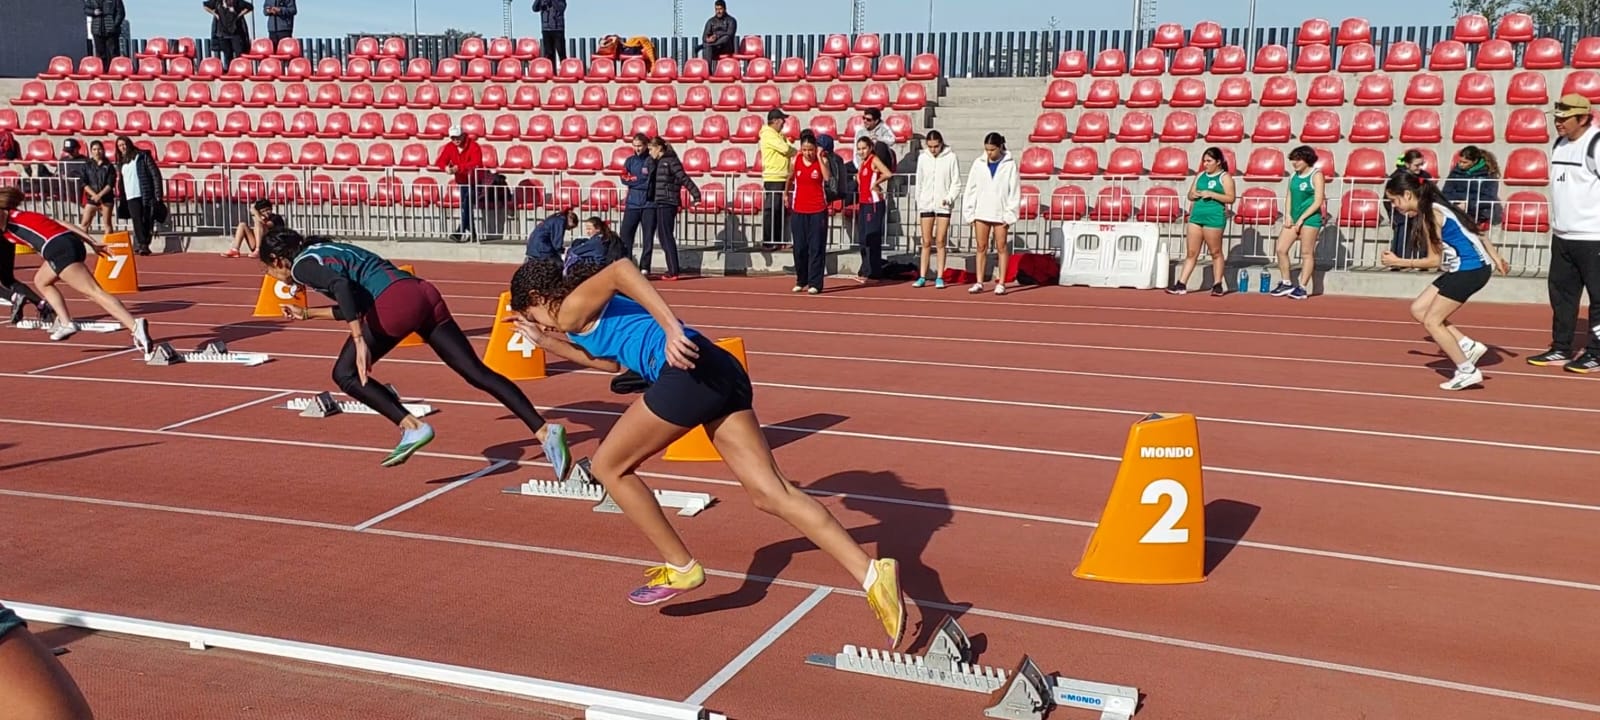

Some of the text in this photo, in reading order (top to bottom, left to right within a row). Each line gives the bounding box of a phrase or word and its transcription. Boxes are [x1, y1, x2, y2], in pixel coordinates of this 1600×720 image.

[107, 254, 129, 279] 7
[507, 330, 536, 358] 4
[1140, 447, 1194, 458] MONDO
[1138, 479, 1189, 543] 2
[1067, 694, 1101, 705] MONDO
